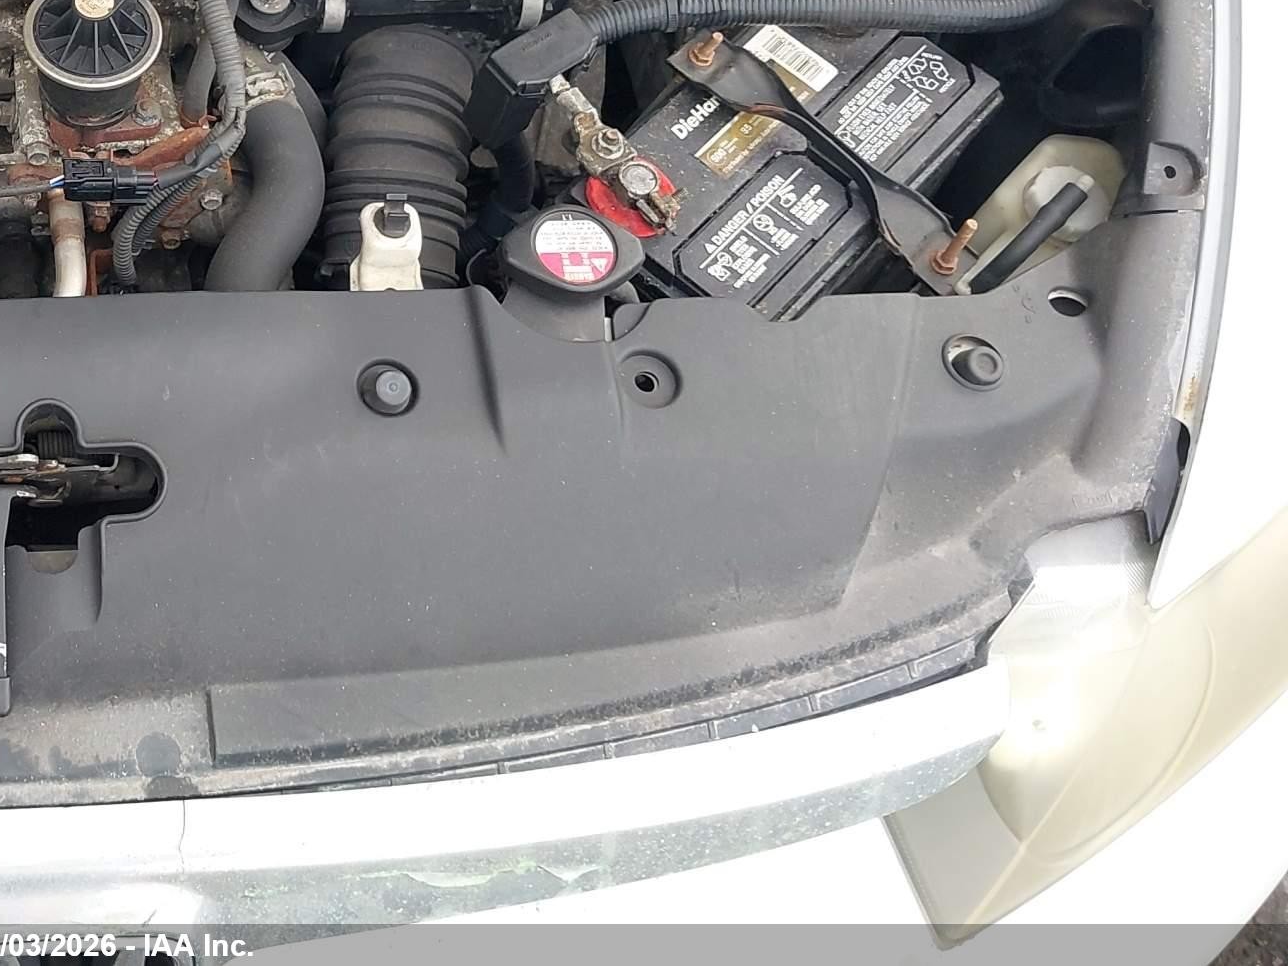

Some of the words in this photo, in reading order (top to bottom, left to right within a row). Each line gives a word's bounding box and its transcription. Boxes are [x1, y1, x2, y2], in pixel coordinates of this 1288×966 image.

[671, 97, 720, 140] DieHar
[711, 208, 749, 246] DANGER
[750, 174, 785, 208] POISON
